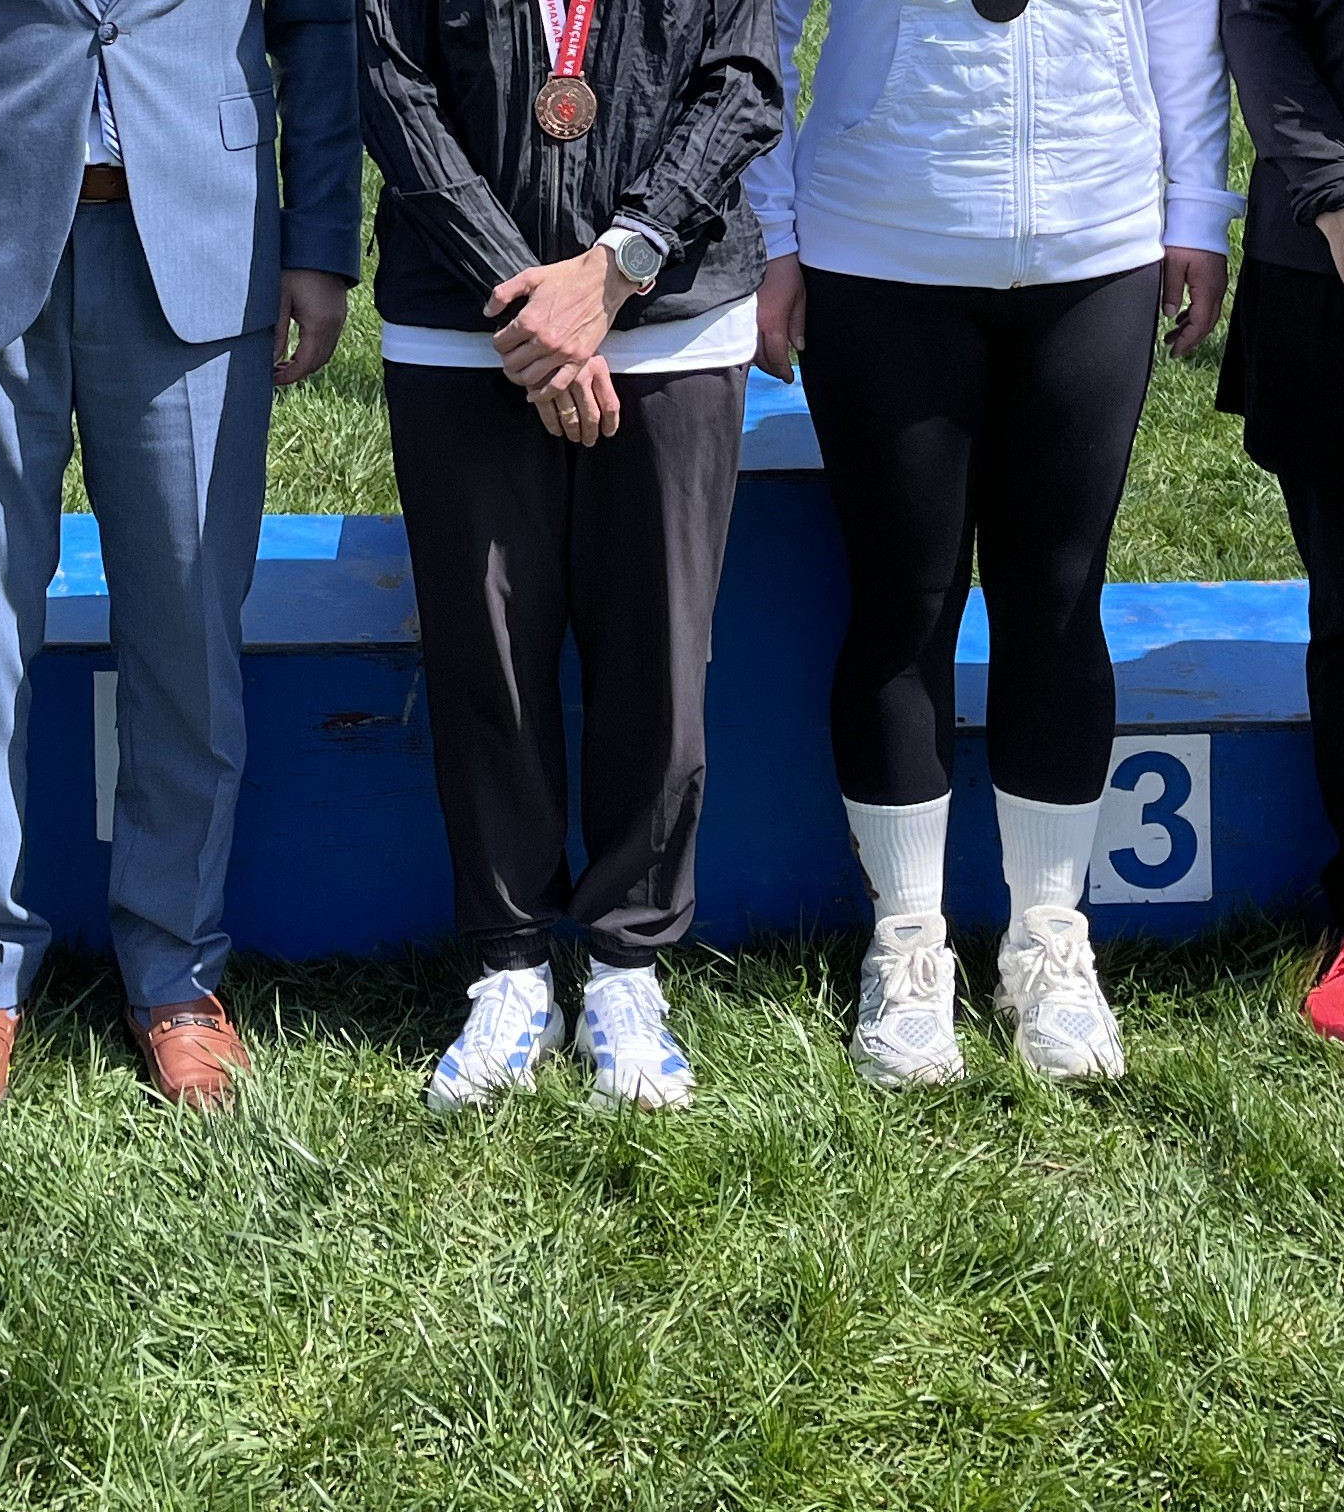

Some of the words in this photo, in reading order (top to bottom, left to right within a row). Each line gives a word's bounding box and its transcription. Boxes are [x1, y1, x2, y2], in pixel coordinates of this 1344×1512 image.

[565, 3, 587, 57] GENÇLİK
[561, 58, 575, 76] VE
[1108, 750, 1198, 890] 3
